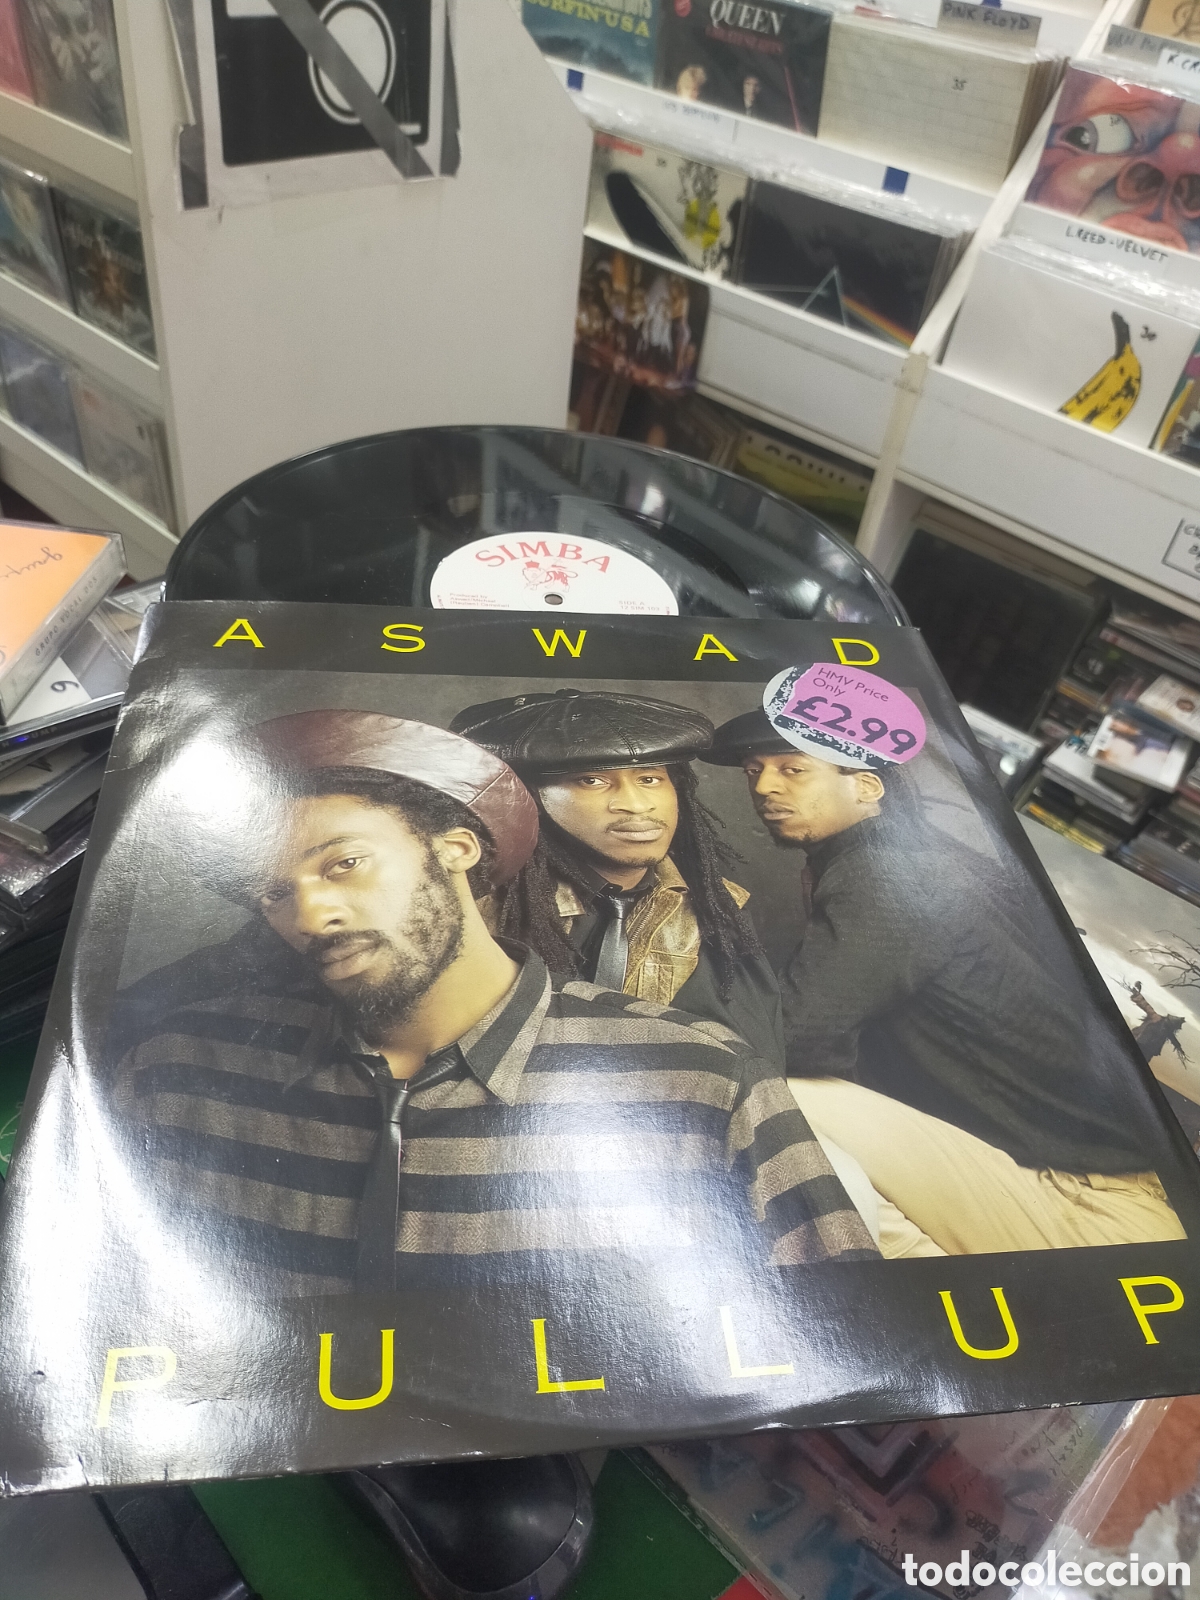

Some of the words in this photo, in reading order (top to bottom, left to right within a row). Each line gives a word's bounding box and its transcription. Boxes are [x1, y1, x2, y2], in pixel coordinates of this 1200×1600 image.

[710, 0, 785, 36] QUEEN
[983, 11, 1030, 31] FLOYD
[475, 541, 611, 573] SIMBA
[212, 618, 881, 666] ASWAD
[813, 677, 845, 697] Only
[818, 667, 854, 686] HMV
[855, 682, 889, 702] Price
[791, 696, 917, 755] £2.99
[93, 1305, 796, 1430] PULL
[938, 1275, 1185, 1360] UP
